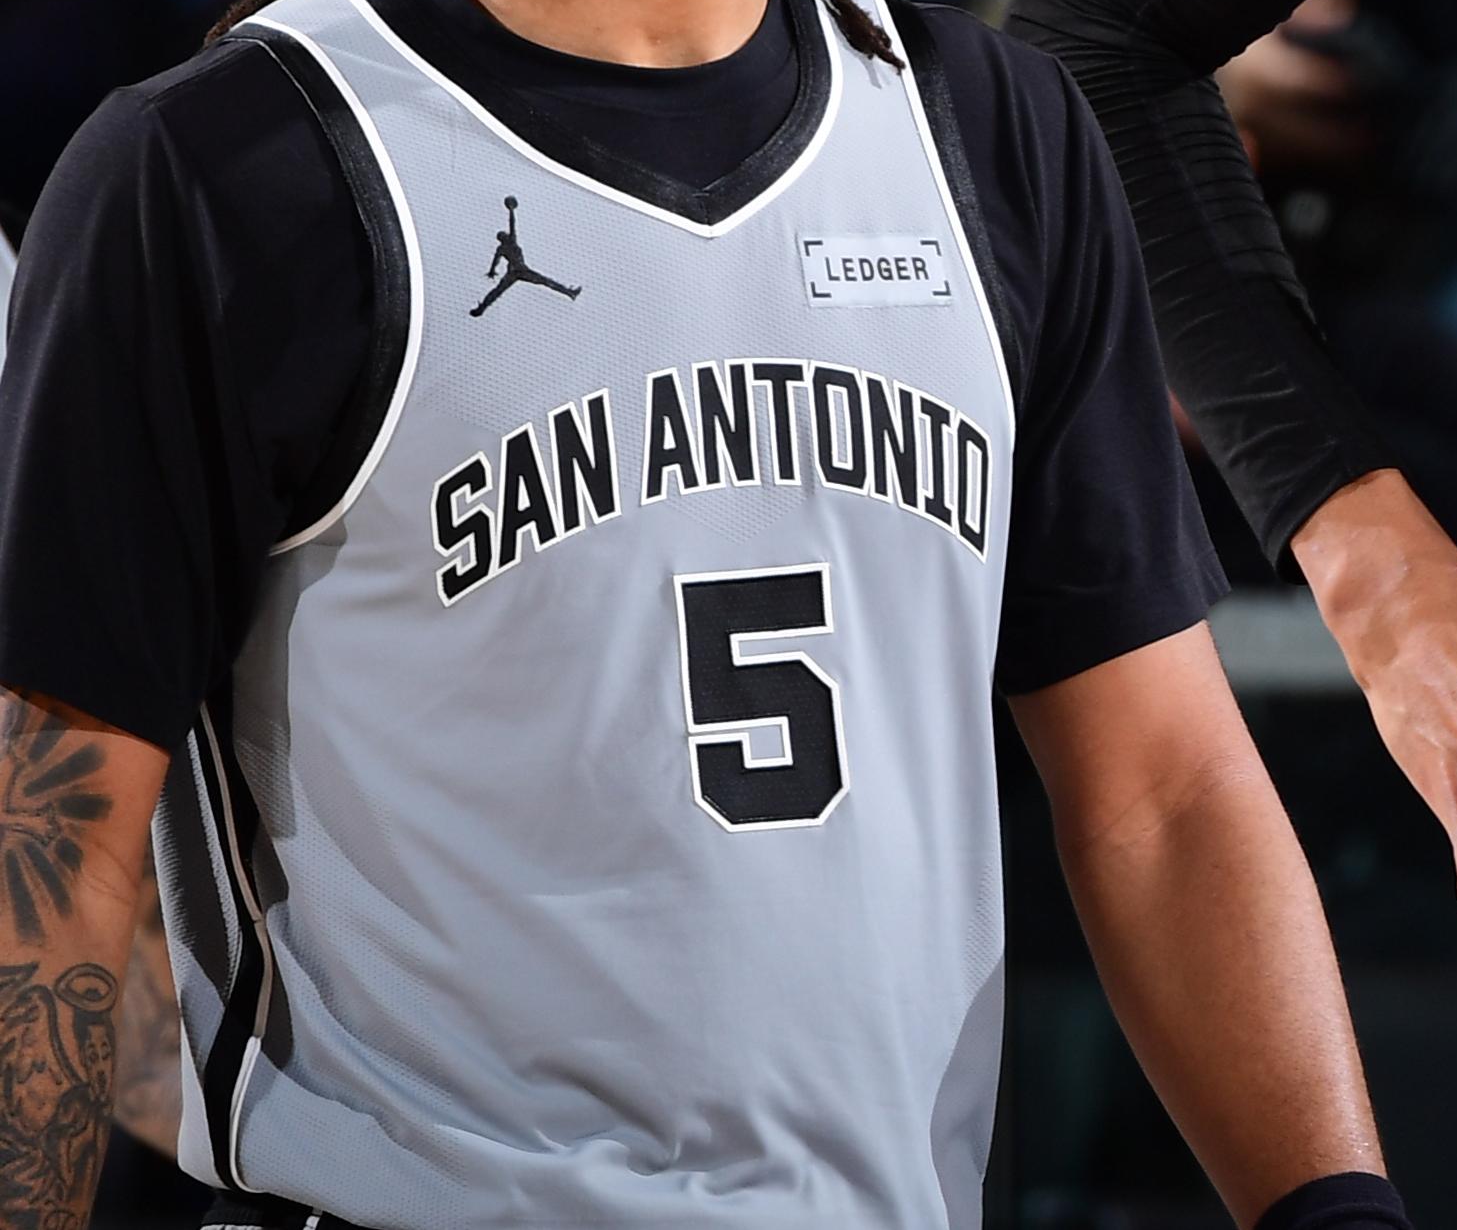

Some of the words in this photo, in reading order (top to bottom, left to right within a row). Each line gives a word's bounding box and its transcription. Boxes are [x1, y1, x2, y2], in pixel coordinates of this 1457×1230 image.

[824, 256, 930, 282] LEDGER
[431, 389, 621, 606] SAN
[640, 358, 991, 563] ANTONIO
[674, 563, 850, 832] 5
